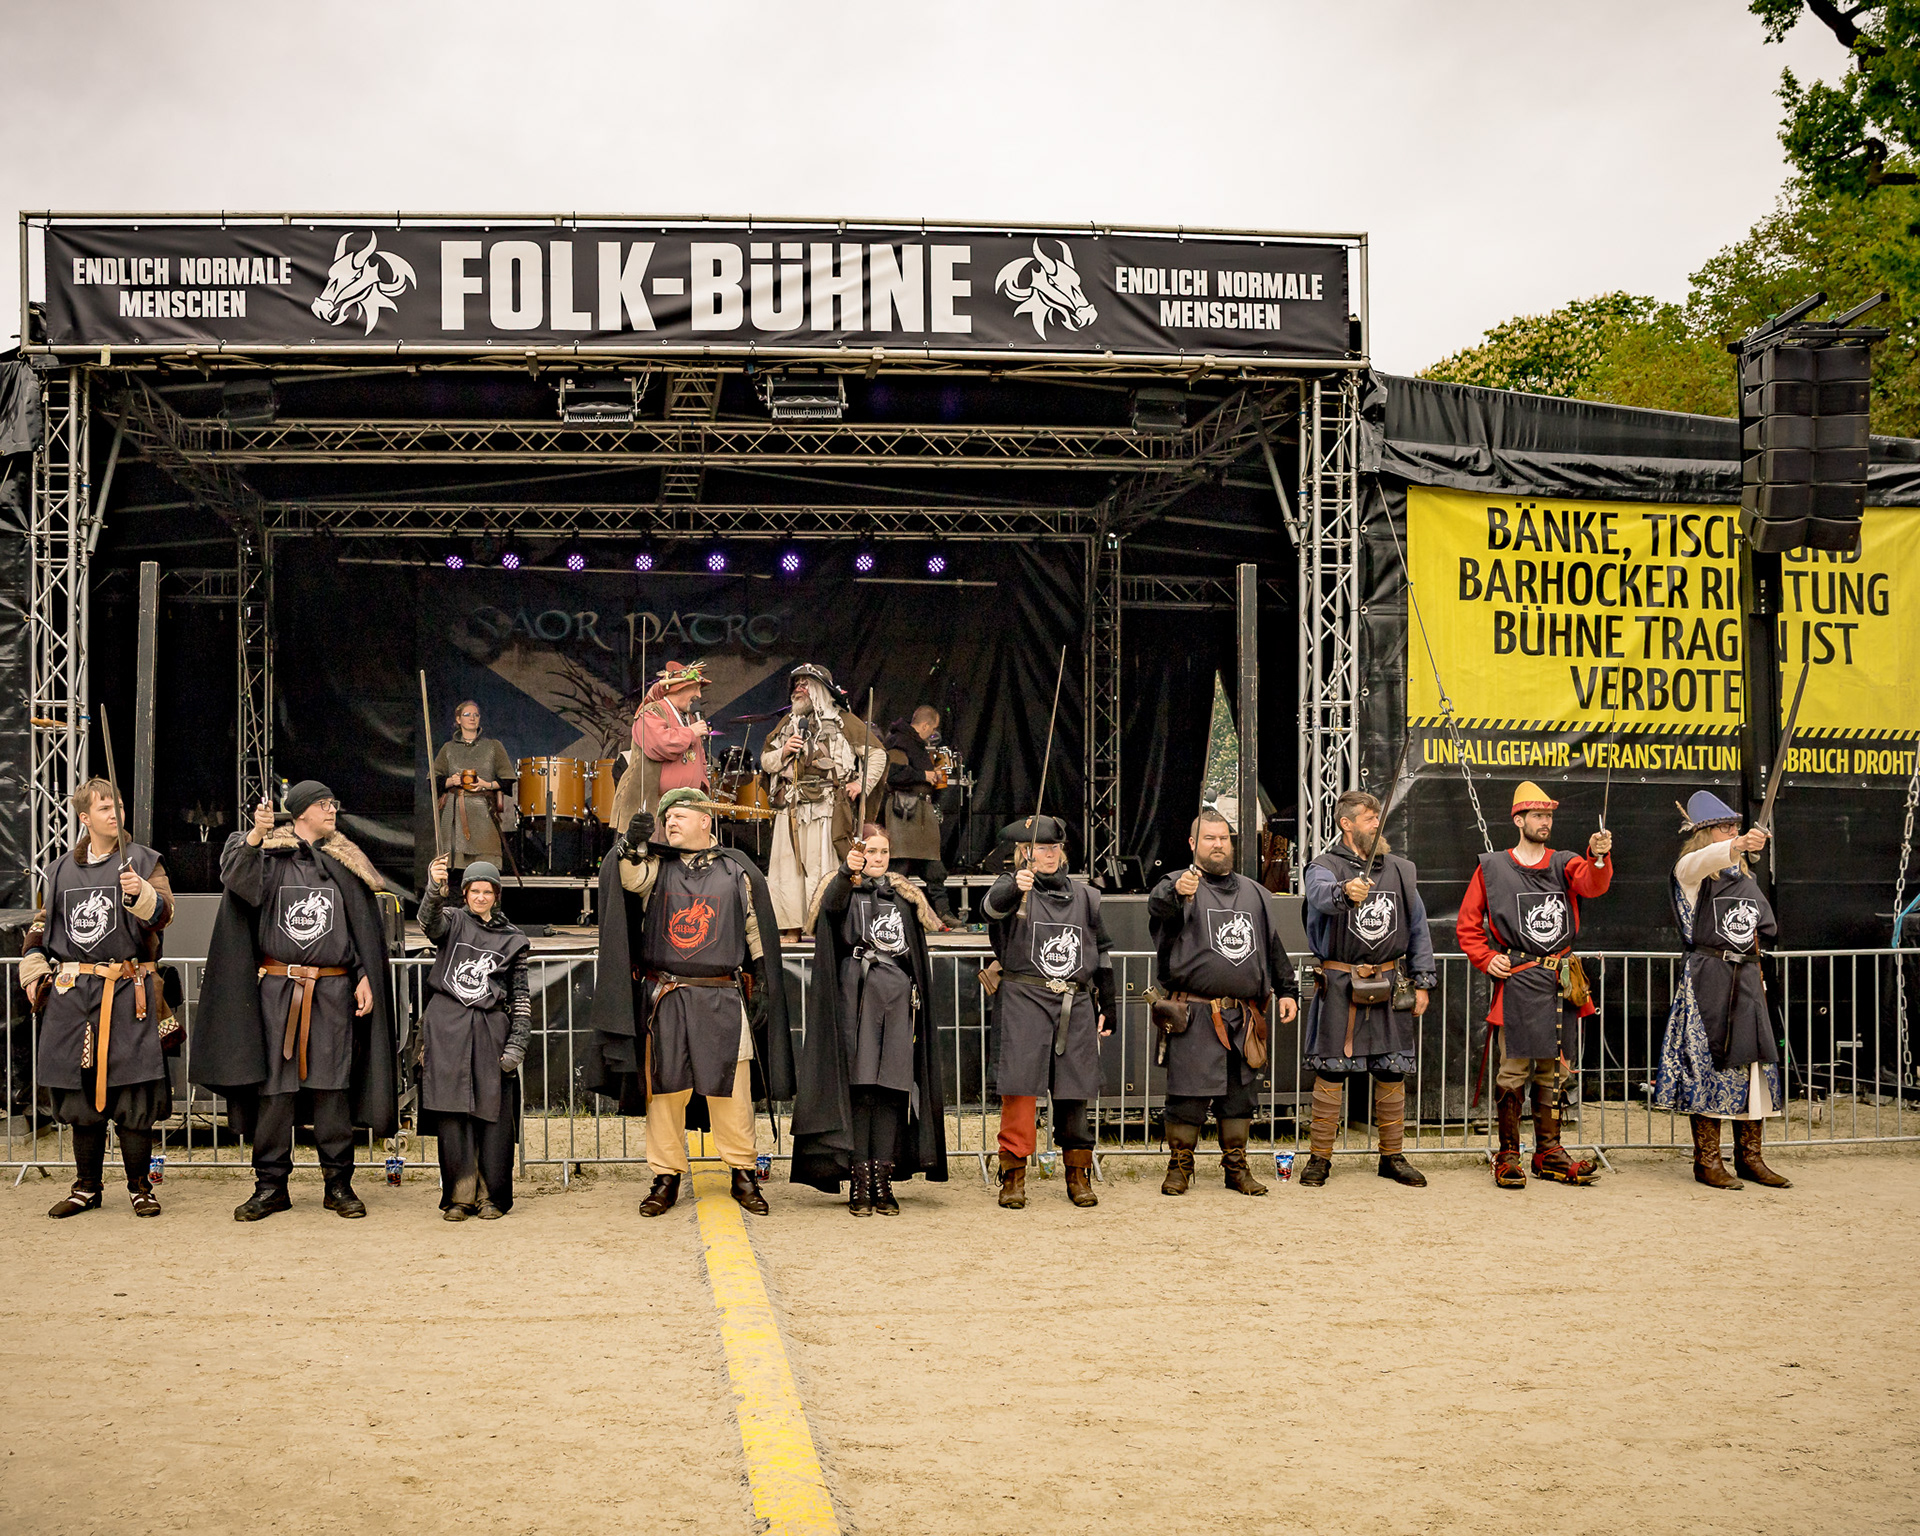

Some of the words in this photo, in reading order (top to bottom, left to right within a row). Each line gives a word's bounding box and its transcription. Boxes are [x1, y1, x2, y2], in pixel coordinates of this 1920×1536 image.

[73, 258, 169, 286] ENDLICH
[180, 257, 292, 285] NORMALE
[440, 241, 972, 334] FOLK-BÜHNE
[1116, 266, 1208, 298] ENDLICH
[1218, 271, 1323, 301] NORMALE
[119, 290, 246, 318] MENSCHEN
[1160, 301, 1281, 330] MENSCHEN
[1487, 503, 1632, 561] BÄNKE,
[1460, 557, 1688, 609] BARHOCKER
[1702, 566, 1889, 616] RITUNG
[623, 610, 803, 660] PATRO
[1495, 605, 1625, 659] BÜHNE
[1635, 616, 1788, 663] TRAG
[1802, 621, 1859, 665] IST
